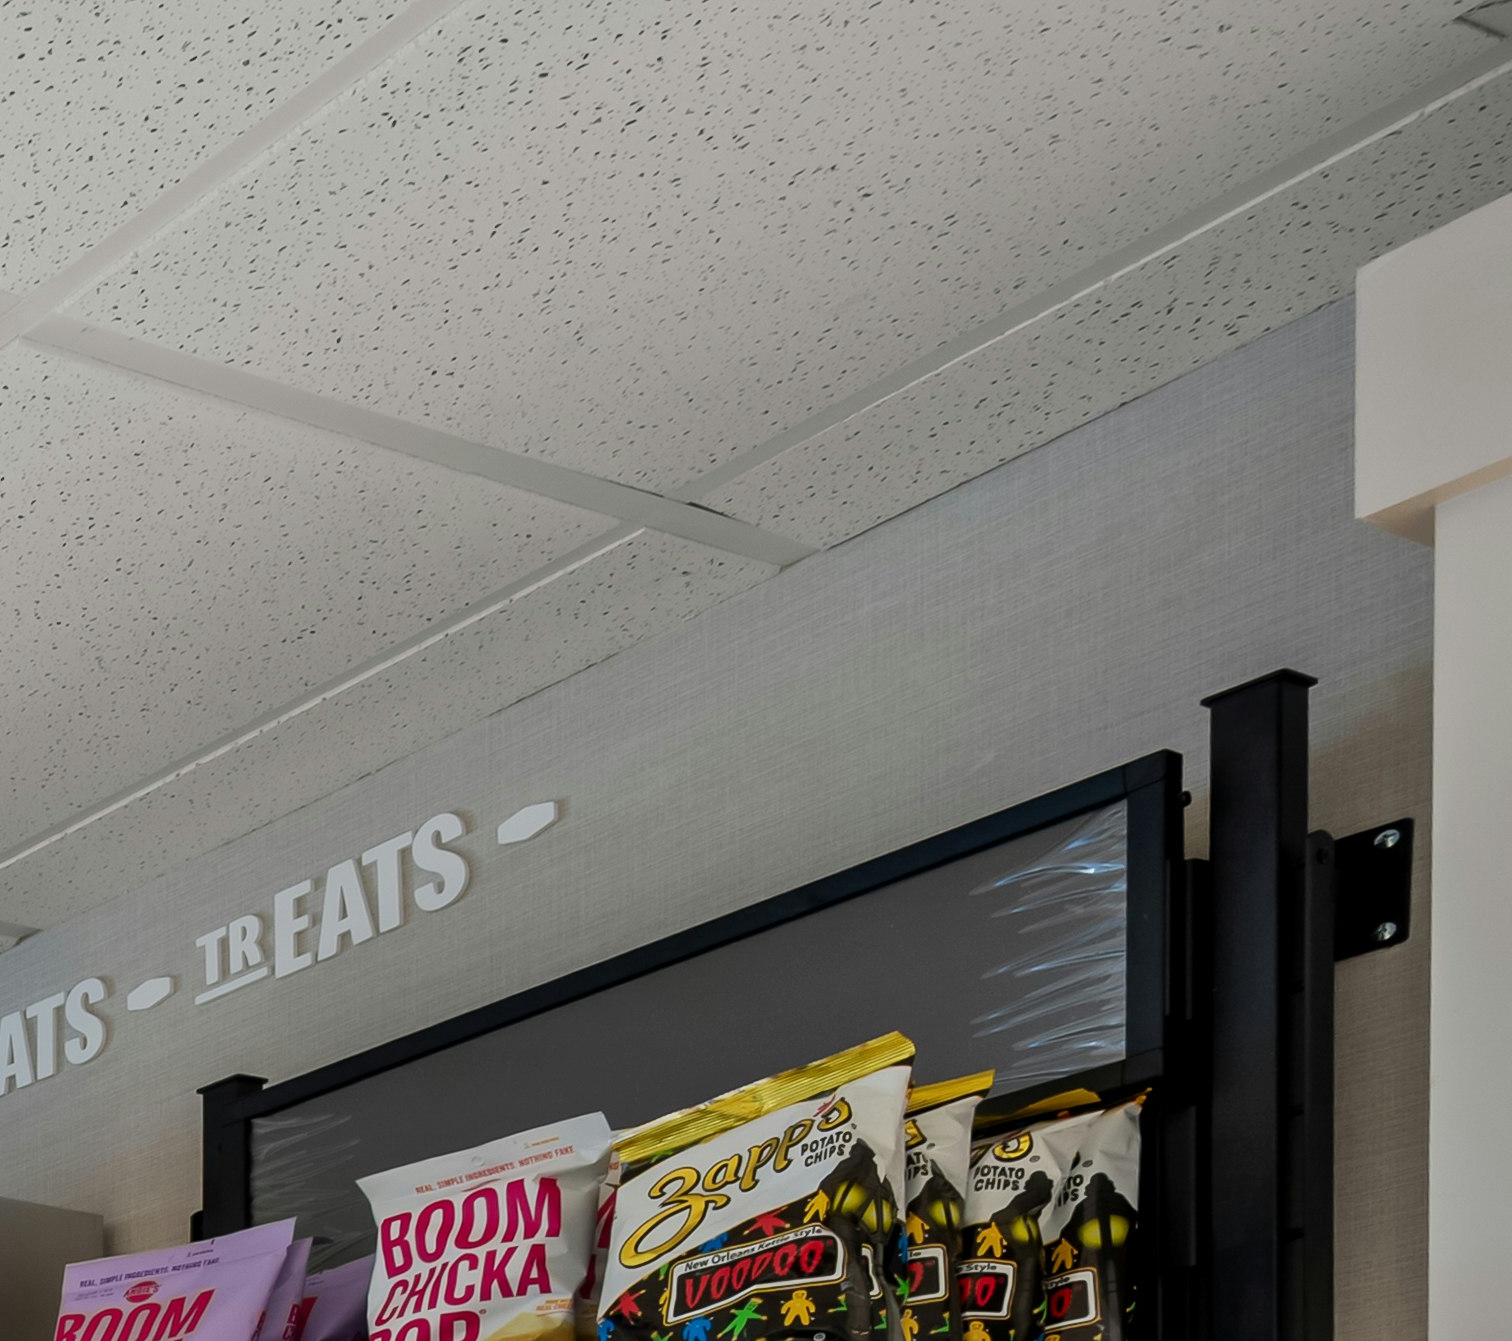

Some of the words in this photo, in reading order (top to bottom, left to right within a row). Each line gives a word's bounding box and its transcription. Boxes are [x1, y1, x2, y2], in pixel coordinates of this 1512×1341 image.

[195, 812, 470, 1002] TREATS
[800, 1131, 852, 1156] POTATO
[804, 1146, 846, 1168] CHIPS
[973, 1165, 1025, 1180] POTATO
[975, 1178, 1020, 1193] CHIPS
[381, 1177, 561, 1279] BOOM
[685, 1260, 709, 1271] New
[711, 1247, 755, 1264] Orleans
[793, 1226, 823, 1241] Style
[375, 1244, 551, 1327] CHICKA
[685, 1240, 825, 1309] VOODOO
